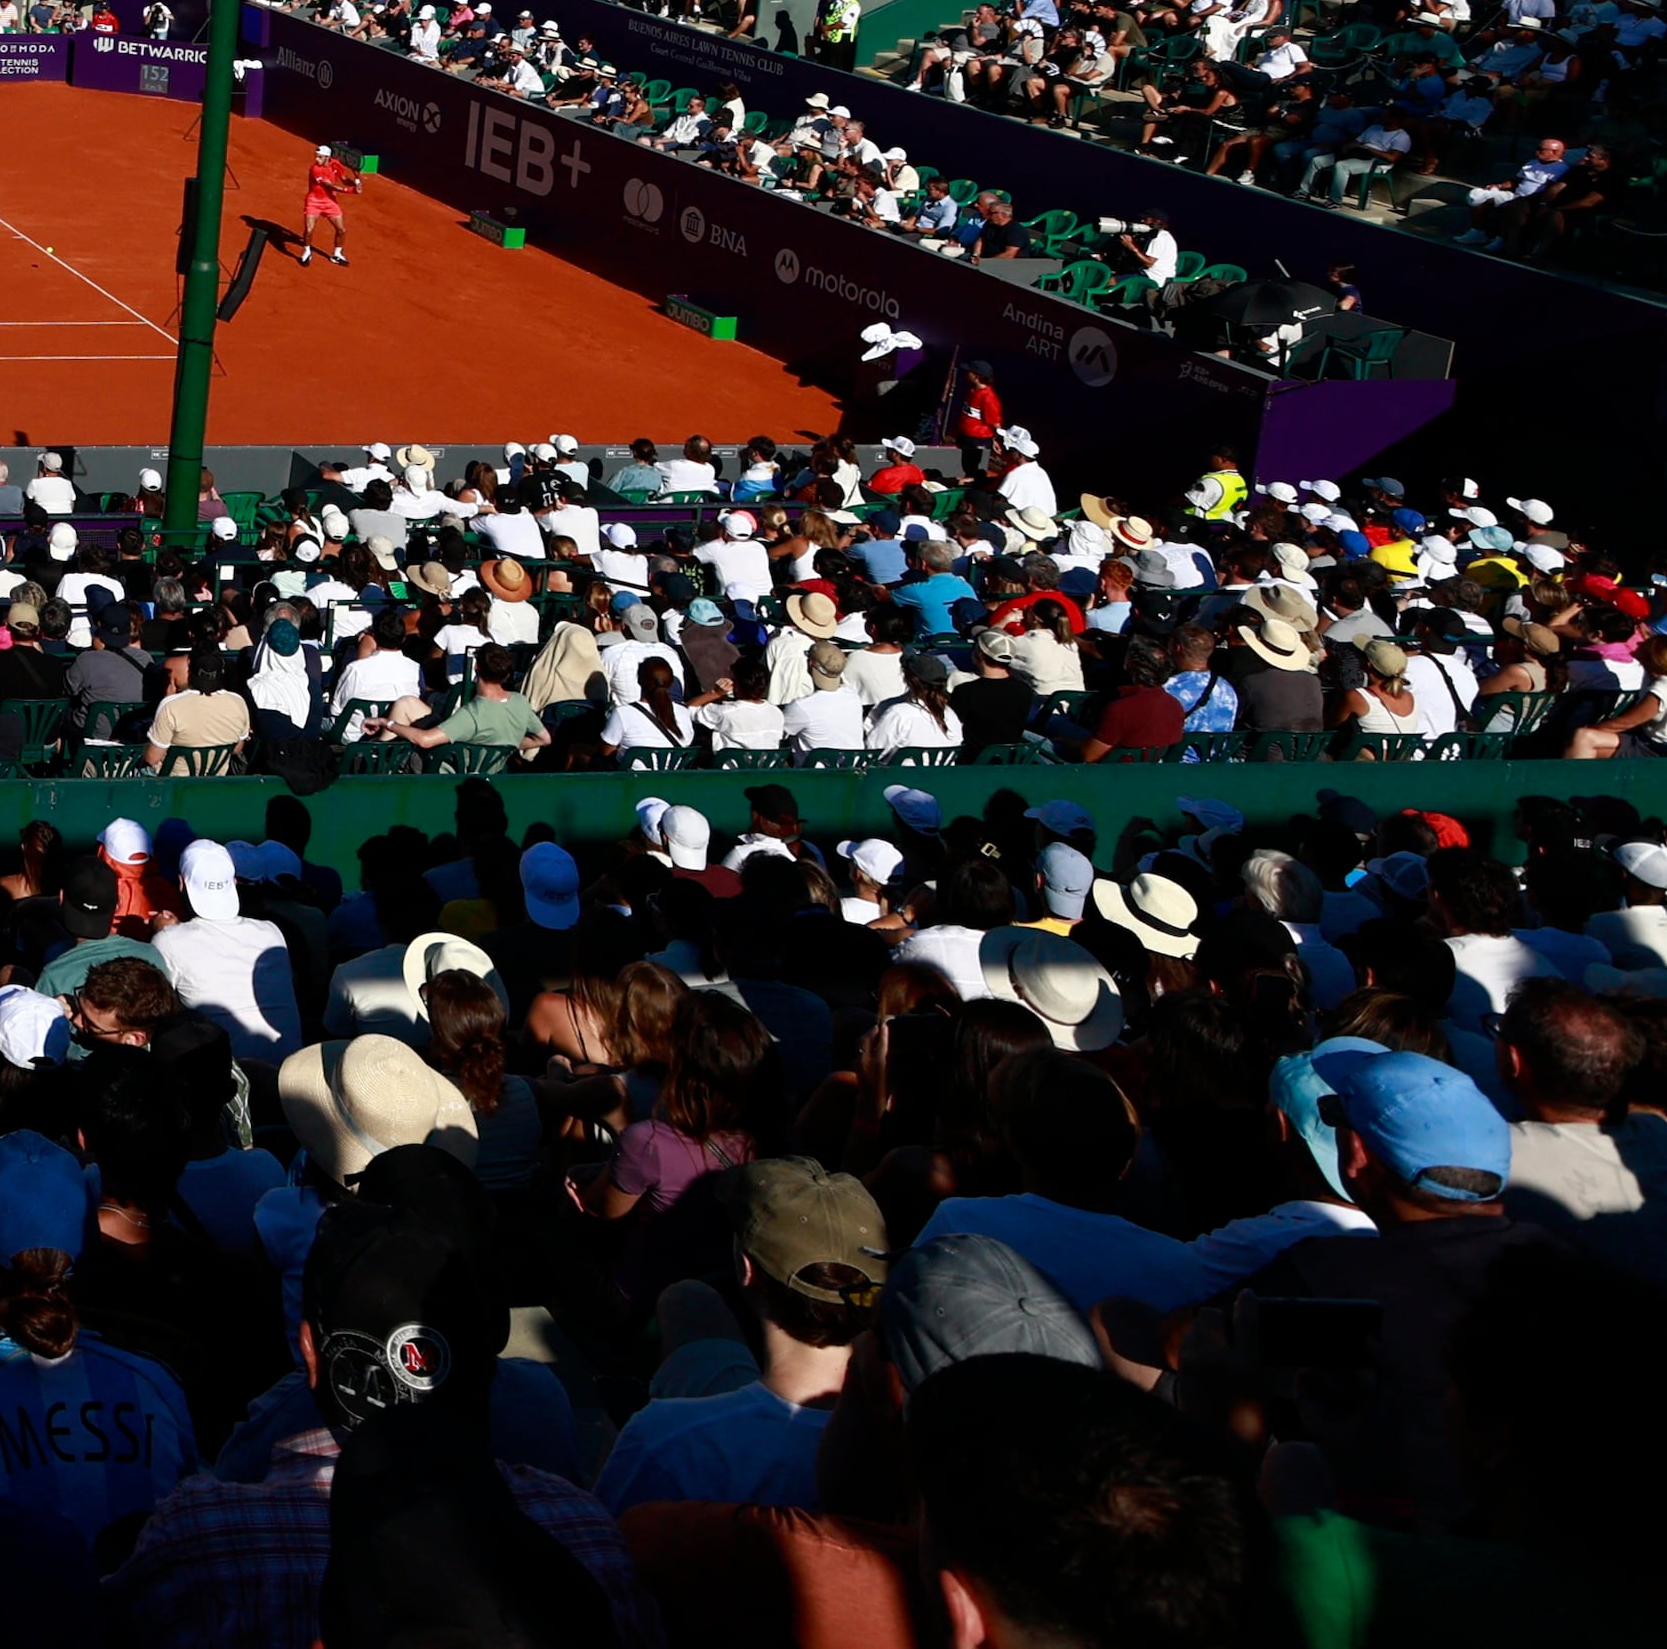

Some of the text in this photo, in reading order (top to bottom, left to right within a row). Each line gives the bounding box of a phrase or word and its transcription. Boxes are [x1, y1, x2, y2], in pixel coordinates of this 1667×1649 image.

[1, 58, 39, 66] TENNIS
[18, 44, 56, 53] MODA
[117, 40, 208, 64] BETWARRIO
[276, 45, 316, 79] Allianz
[628, 18, 784, 77] BUENOS AIRES LAWN TENNIS CLUB
[142, 65, 169, 81] 152
[374, 87, 420, 121] AXION
[464, 99, 592, 197] IEB+
[709, 223, 748, 258] BNA
[804, 265, 900, 320] motorola
[667, 299, 710, 332] JUMBO
[1002, 302, 1065, 341] Andina
[1024, 333, 1062, 363] ART
